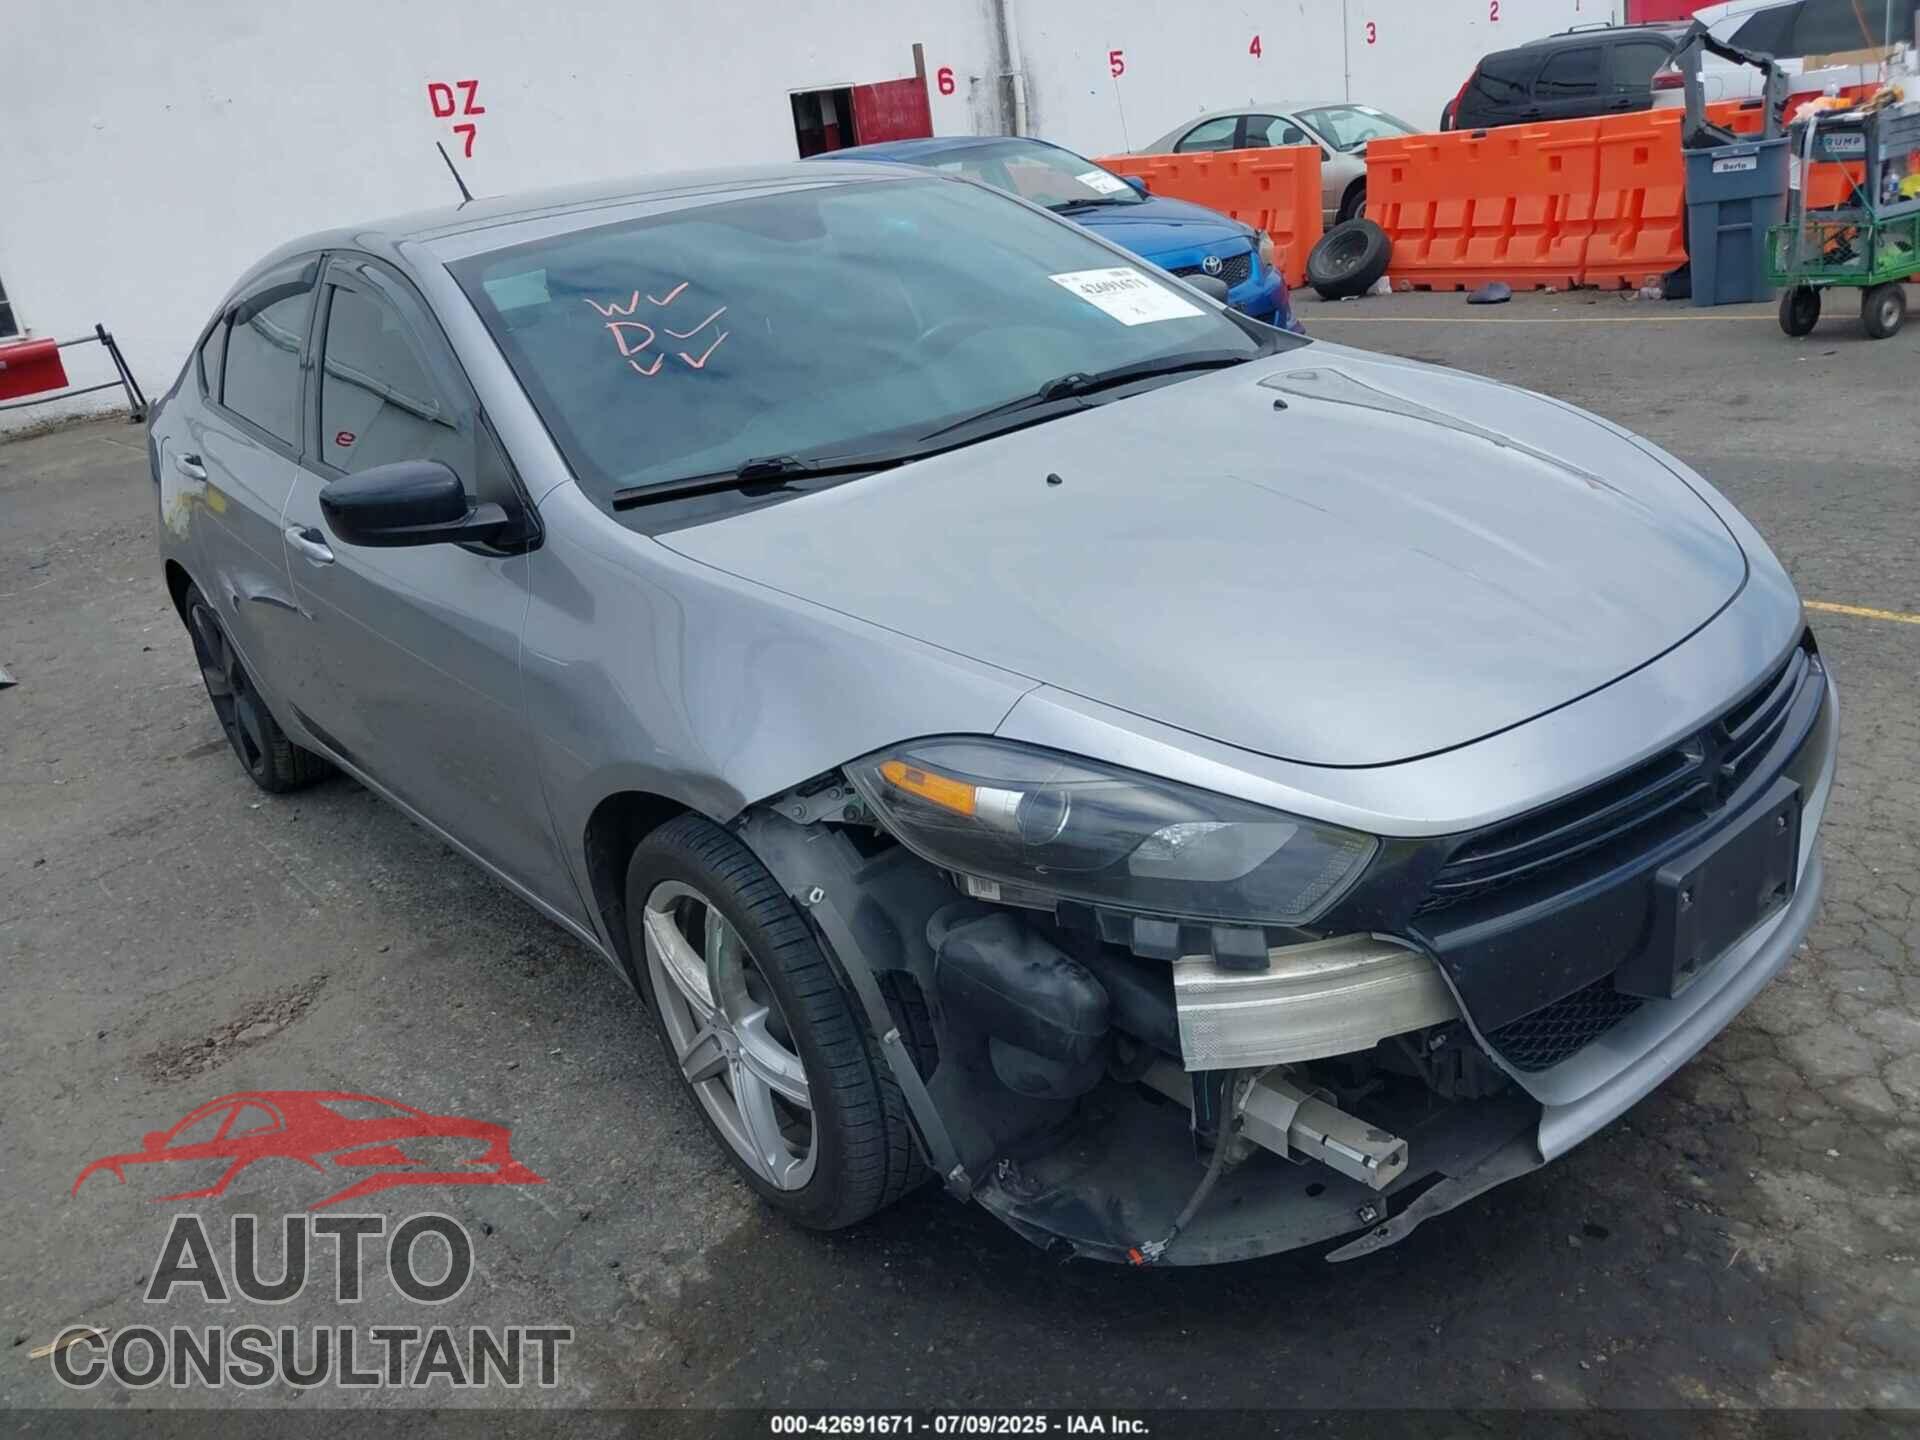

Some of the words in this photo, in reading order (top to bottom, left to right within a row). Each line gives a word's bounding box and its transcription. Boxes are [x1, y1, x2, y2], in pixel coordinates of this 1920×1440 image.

[1489, 0, 1500, 21] 2
[1248, 34, 1262, 59] 4
[1365, 21, 1377, 45] 3
[1109, 50, 1125, 78] 5
[937, 67, 955, 96] 6
[427, 79, 486, 118] DZ
[452, 122, 476, 158] 7
[604, 321, 656, 357] D
